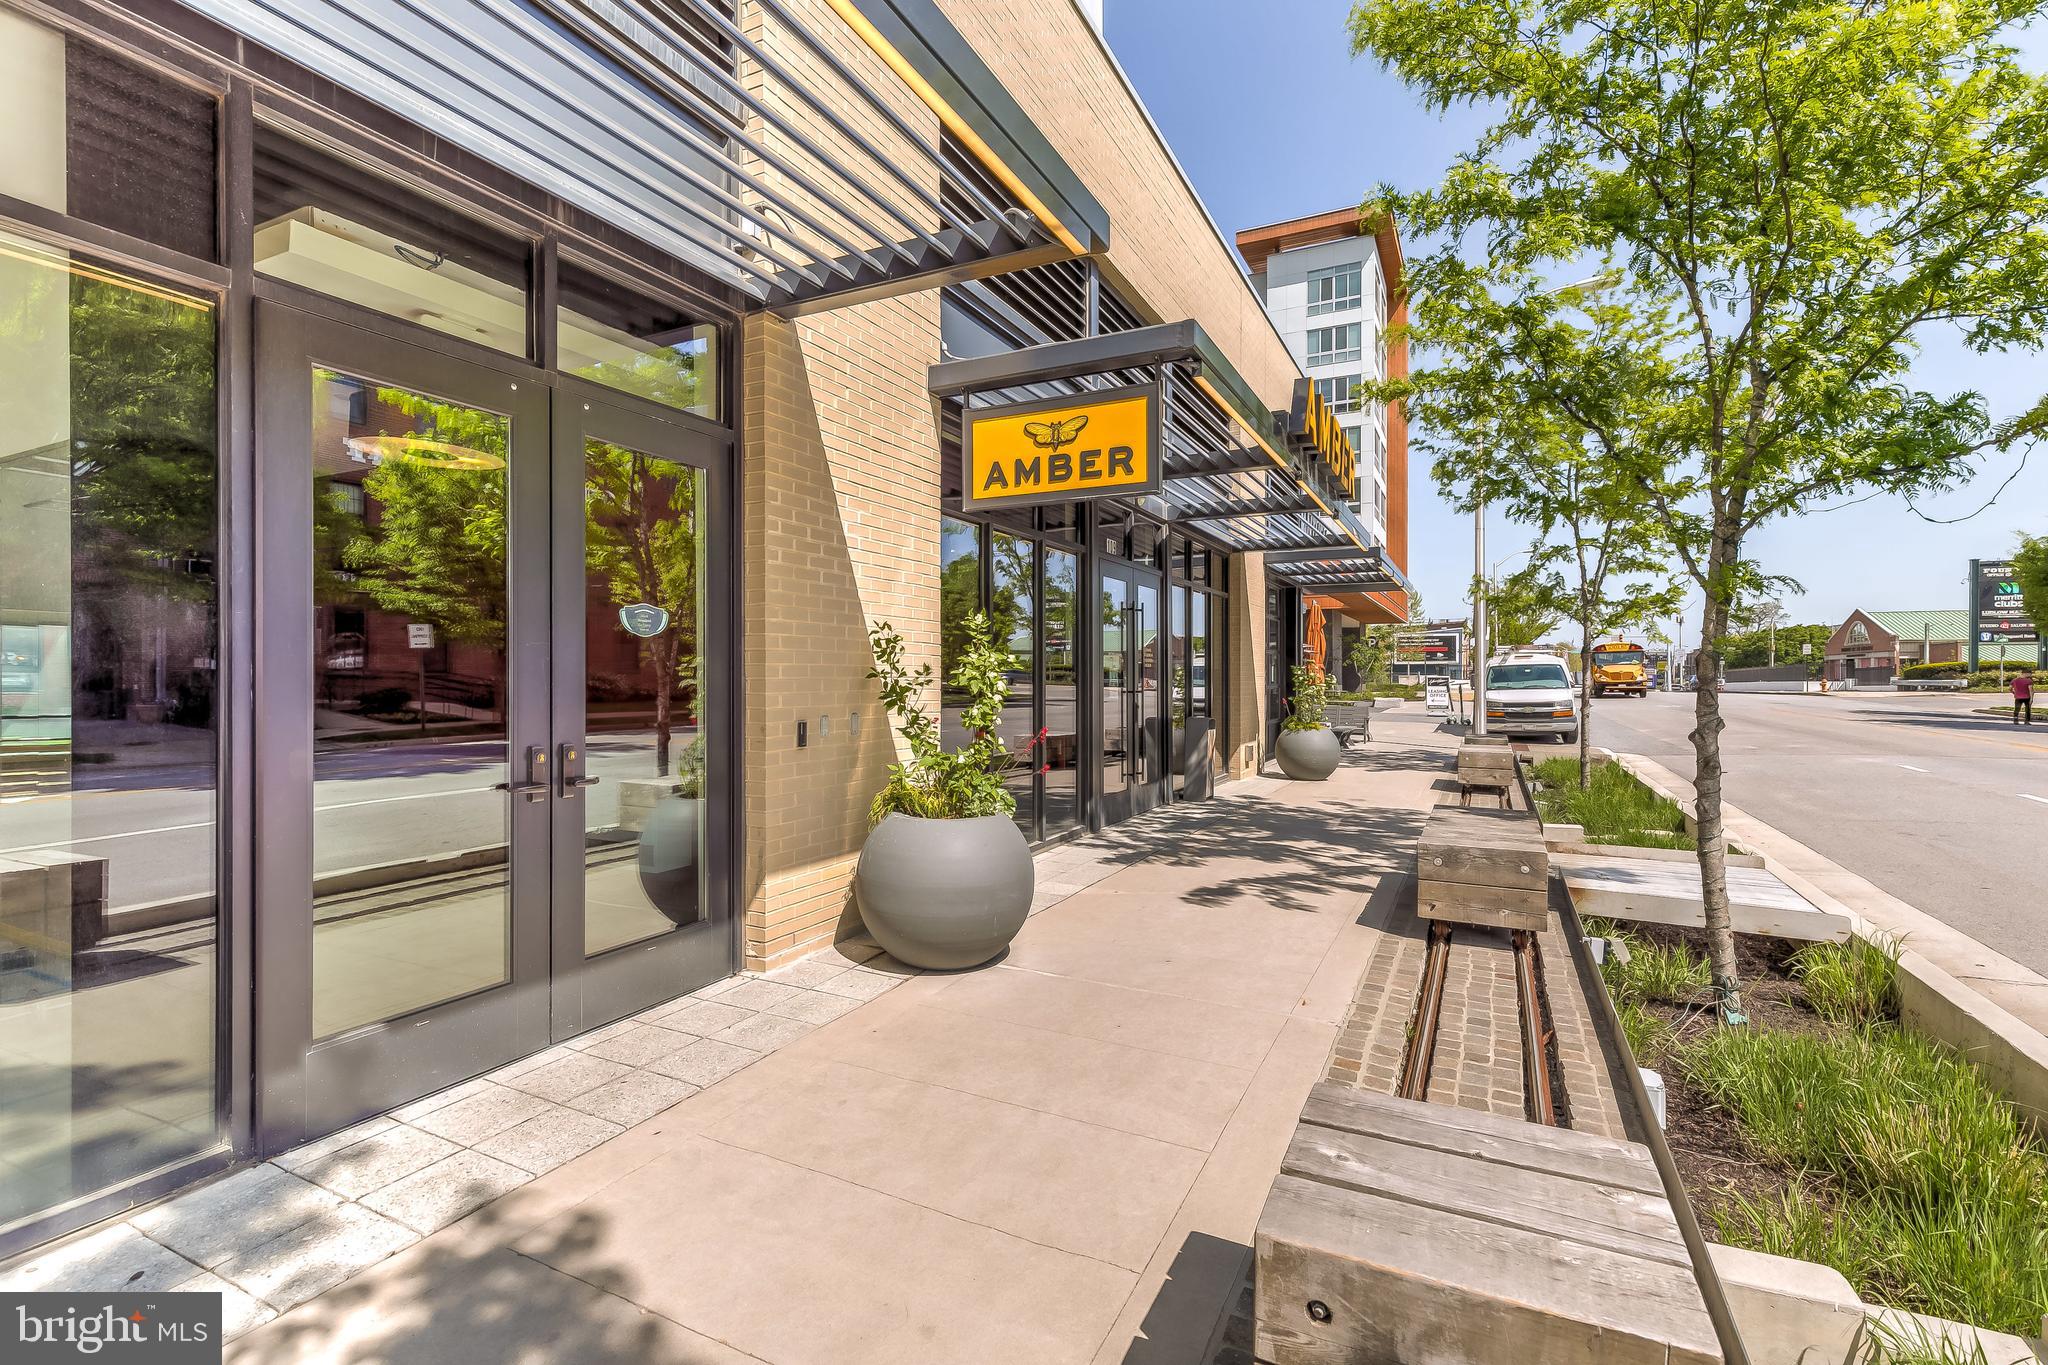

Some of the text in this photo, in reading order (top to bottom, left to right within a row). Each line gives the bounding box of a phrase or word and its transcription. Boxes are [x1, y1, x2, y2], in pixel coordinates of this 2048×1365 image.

[1303, 376, 1356, 500] AMBER
[983, 445, 1134, 491] AMBER
[1994, 600, 2024, 608] clubs
